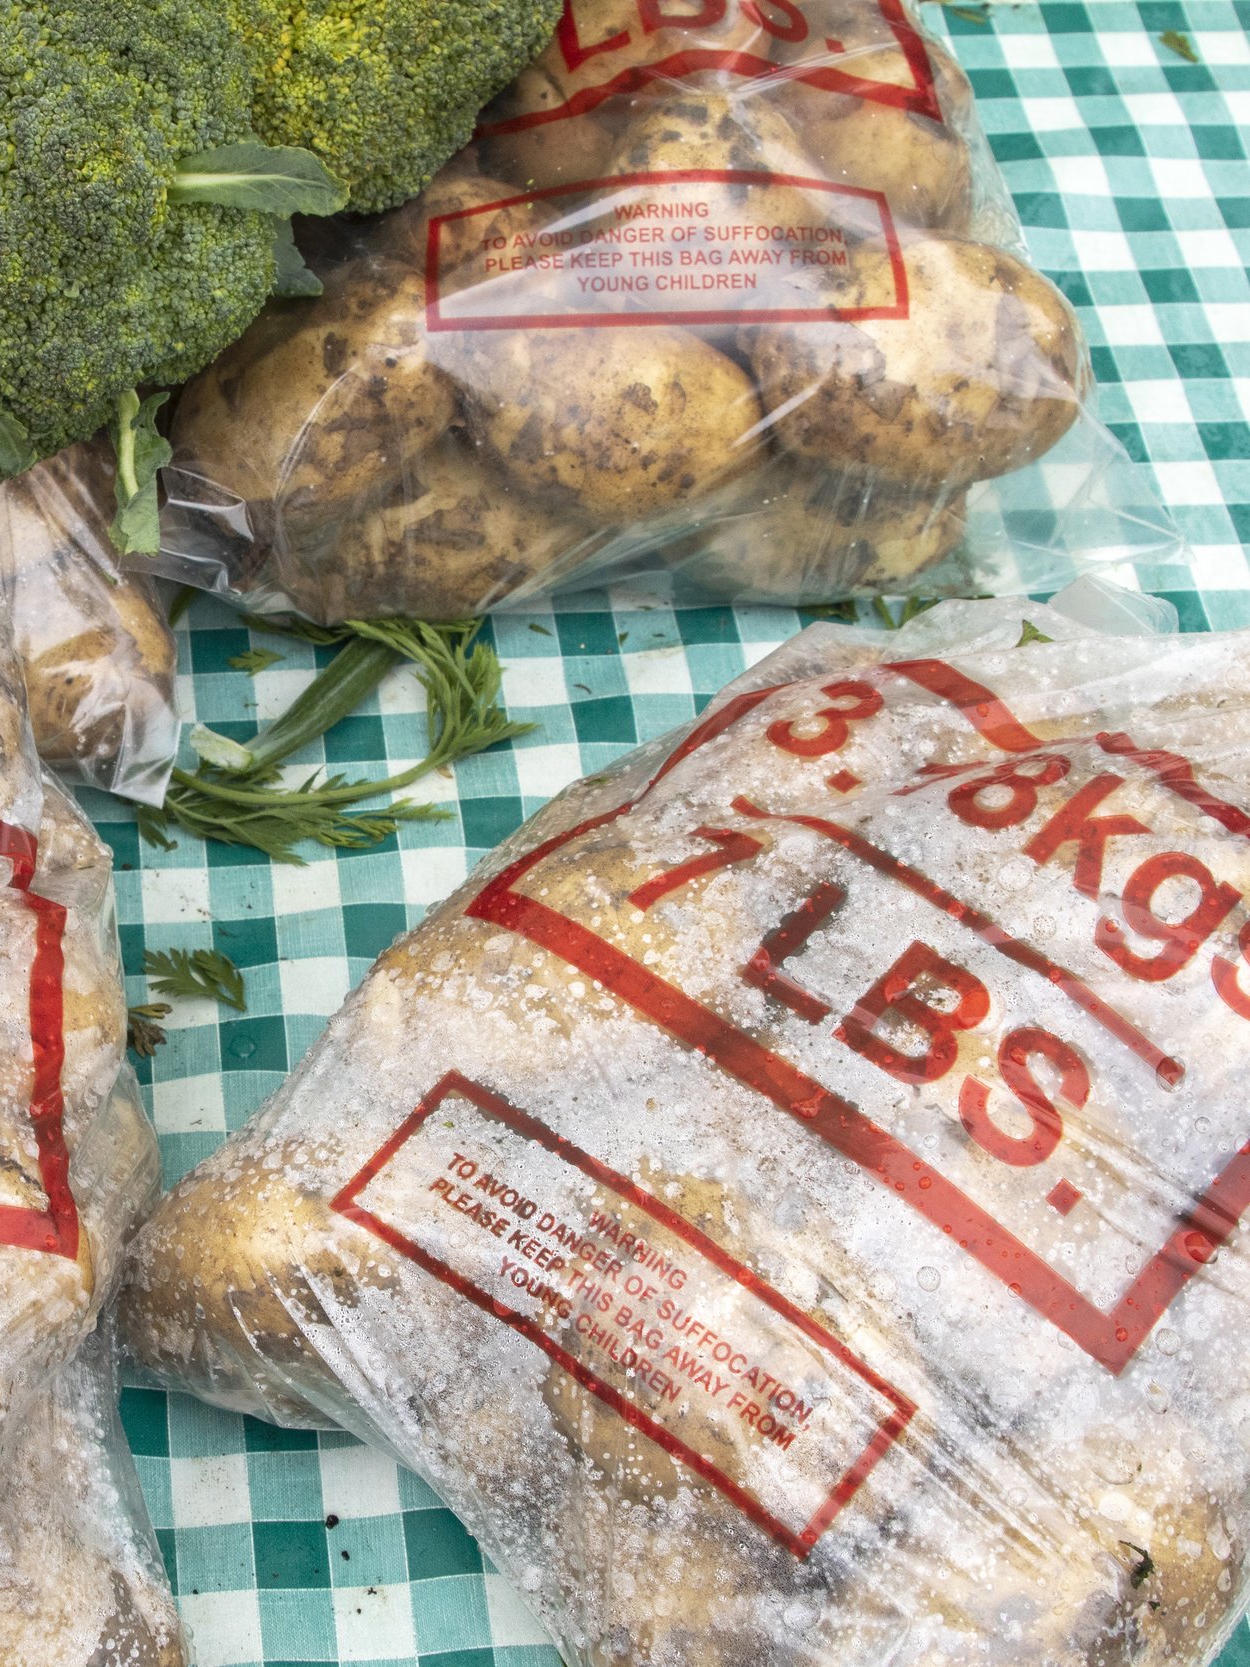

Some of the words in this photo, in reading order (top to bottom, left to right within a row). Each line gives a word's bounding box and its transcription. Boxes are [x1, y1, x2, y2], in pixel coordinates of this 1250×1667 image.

[482, 236, 507, 251] TO
[513, 232, 573, 249] AVOID
[580, 228, 664, 244] DANGER
[671, 226, 697, 242] OF
[704, 226, 847, 246] SUFFOCATION,
[614, 203, 709, 220] WARNING
[485, 254, 564, 272] PLEASE
[570, 252, 623, 268] KEEP
[629, 251, 673, 267] THIS
[680, 250, 723, 266] BAG
[728, 249, 783, 265] AWAY
[790, 250, 847, 266] FROM
[578, 276, 649, 292] YOUNG
[655, 274, 757, 291] CHILDREN
[627, 826, 764, 913] 7
[738, 882, 1084, 1217] LBS.
[589, 1210, 688, 1291] WARNING
[428, 1176, 511, 1239] PLEASE
[507, 1229, 565, 1273] KEEP
[567, 1268, 614, 1313] THIS
[613, 1304, 664, 1350] BAG
[663, 1345, 730, 1398] AWAY
[726, 1391, 797, 1452] FROM
[448, 1152, 478, 1180] TO
[473, 1173, 538, 1220] AVOID
[536, 1212, 623, 1283] DANGER
[624, 1275, 658, 1303] OF
[656, 1299, 814, 1431] SUFFOCATION,
[500, 1255, 573, 1319] YOUNG
[575, 1313, 683, 1403] CHILDREN
